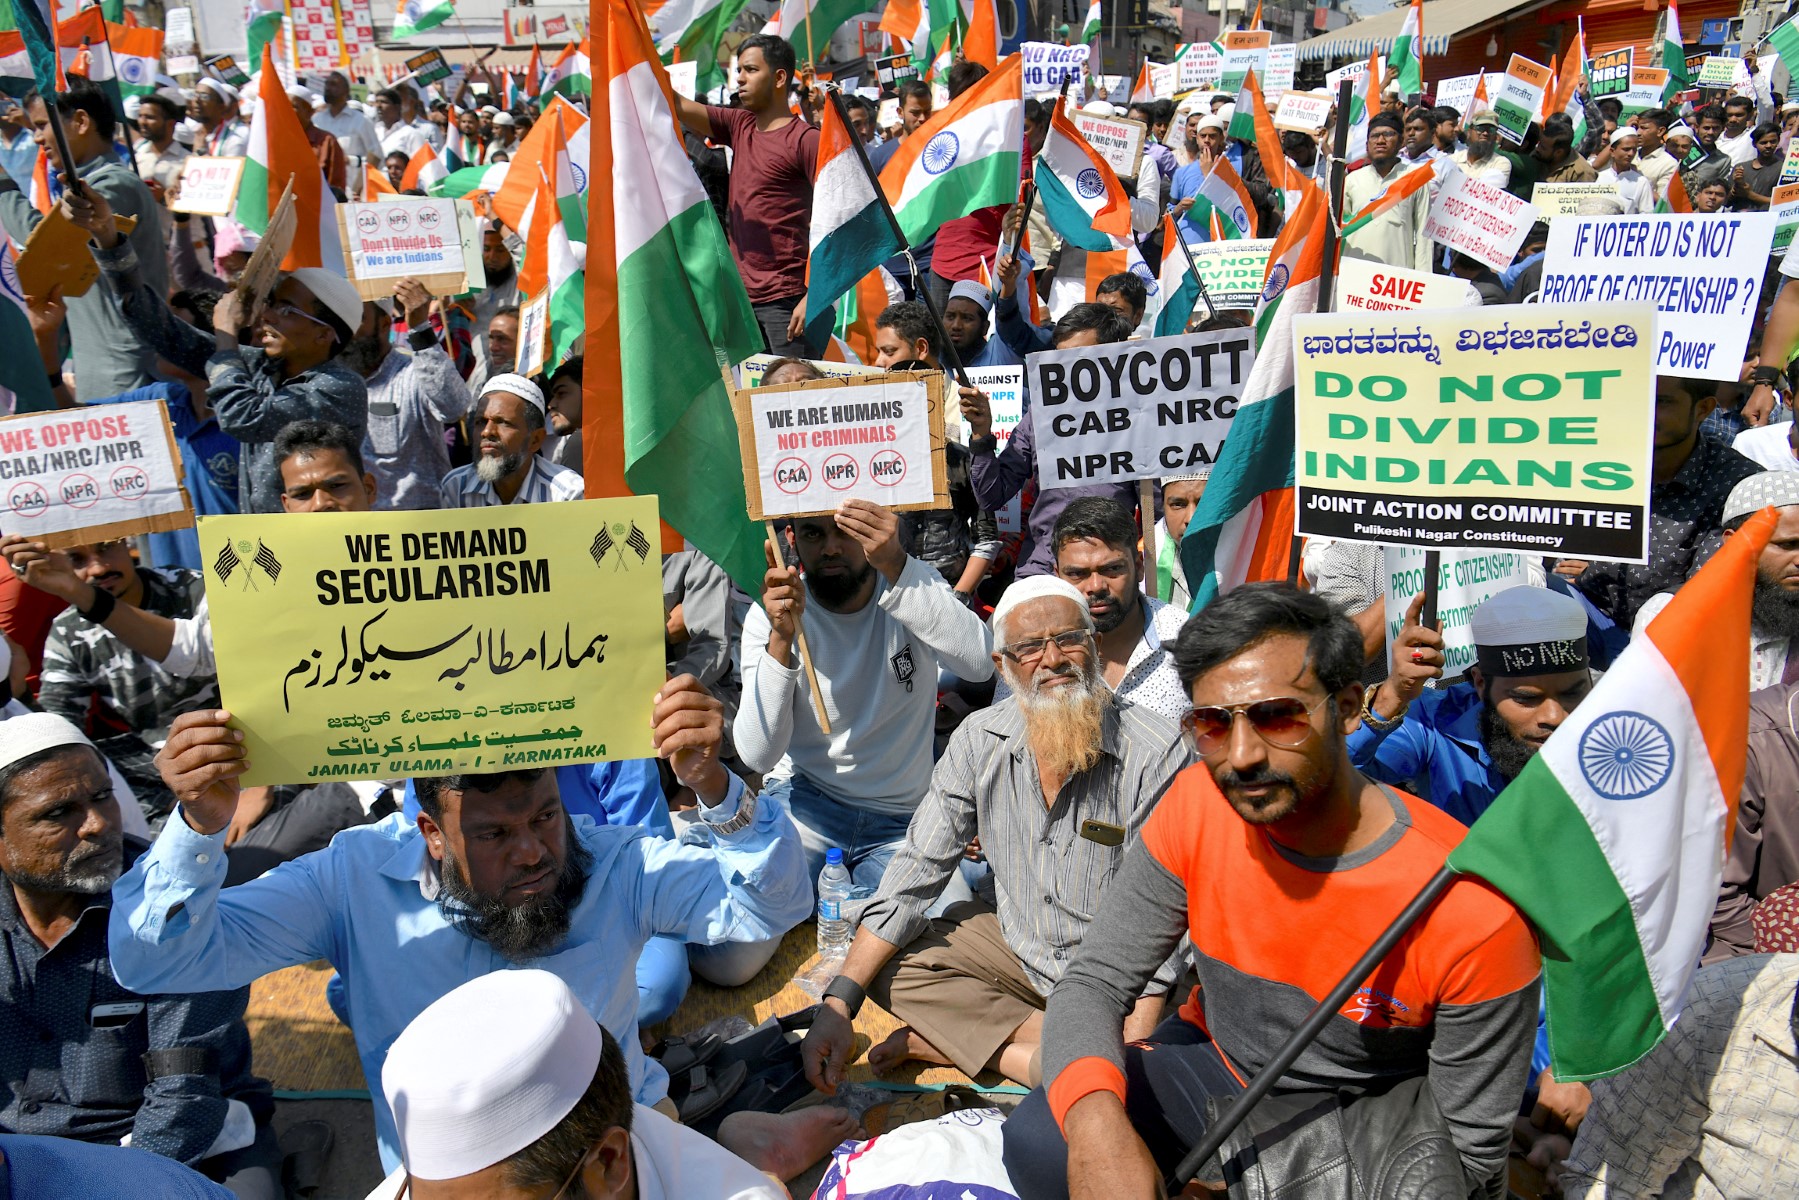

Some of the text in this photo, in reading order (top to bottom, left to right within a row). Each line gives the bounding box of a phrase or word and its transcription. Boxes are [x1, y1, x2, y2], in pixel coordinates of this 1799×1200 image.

[1047, 48, 1086, 63] NRC
[1594, 52, 1628, 70] CAA
[893, 65, 917, 78] NRC
[1592, 65, 1628, 83] NRC
[1507, 84, 1533, 101] भारतीय
[1592, 78, 1626, 96] NPR
[1281, 108, 1320, 122] HATE POLITICS
[1287, 98, 1320, 111] STOP
[1080, 131, 1128, 149] AA/NRC/NPR
[1082, 120, 1128, 138] WE OPPOSE
[1461, 177, 1472, 192] IF
[1467, 180, 1502, 206] AADHAAR
[1506, 199, 1523, 216] NOT
[358, 213, 438, 227] CAA NPR NRC
[1442, 196, 1468, 218] PROOF
[1463, 206, 1477, 221] OF
[1473, 210, 1512, 239] CITIZENSHIP
[362, 234, 443, 253] Don't Divide Us
[1471, 237, 1489, 256] Bank
[1487, 245, 1512, 268] Account
[1573, 223, 1591, 257] IF
[1594, 221, 1650, 257] VOTER
[1649, 221, 1671, 257] ID
[1674, 220, 1695, 257] IS
[1695, 220, 1741, 257] NOT
[366, 252, 443, 266] We are Indians
[1201, 270, 1264, 280] IVIDE
[1370, 274, 1426, 303] SAVE
[1347, 295, 1364, 307] THE
[1543, 274, 1755, 315] PROOF OF CITIZENSHIP ?
[1303, 320, 1638, 366] ಭಾರತವನ್ನು ವಿಭಜಿಸಬೇಡಿ
[1657, 331, 1715, 370] Power
[977, 375, 1020, 384] AGAINST
[1039, 339, 1248, 406] BOYCOTT
[1314, 369, 1621, 403] DO NOT
[992, 391, 1015, 400] NPR
[767, 401, 903, 429] WE ARE HUMANS
[995, 414, 1019, 422] Just
[1053, 395, 1238, 437] CAB NRC
[1328, 413, 1598, 445] DIVIDE
[0, 415, 131, 454] WE OPPOSE
[777, 425, 897, 451] NOT CRIMINALS
[0, 440, 144, 480] CAA/NRC/NPR
[777, 460, 903, 483] CAA NPR NRC
[1057, 451, 1135, 480] NPR
[1305, 451, 1635, 491] INDIANS
[12, 475, 145, 509] CAA NPR NRC
[1307, 495, 1632, 530] JOINT ACTION COMMITTEE
[345, 527, 527, 563] WE DEMAND
[1354, 523, 1563, 547] Pulikeshi Nagar Constituency
[315, 558, 551, 606] SECULARISM
[1391, 568, 1425, 600] PROO
[1454, 553, 1514, 588] CITIZENSHIP
[283, 608, 474, 714] سیکولرزم
[438, 627, 537, 691] مطالبہ
[1503, 639, 1582, 672] NO NRC
[308, 762, 381, 777] JAMIAT
[389, 758, 453, 773] ULAMA
[503, 743, 607, 766] KARNATAKA
